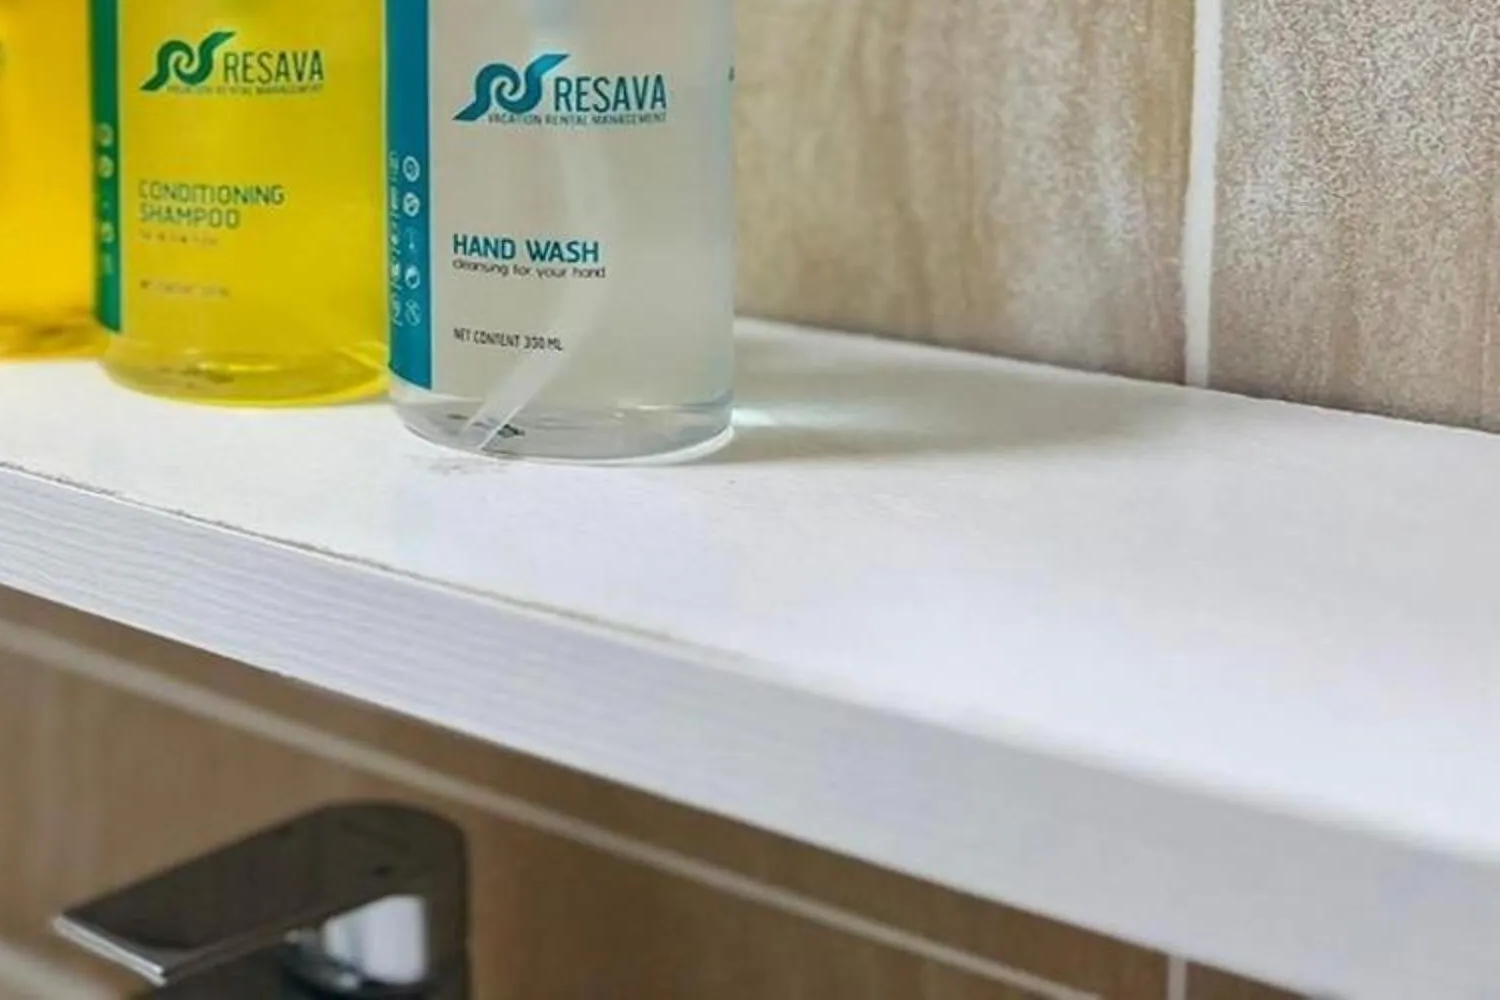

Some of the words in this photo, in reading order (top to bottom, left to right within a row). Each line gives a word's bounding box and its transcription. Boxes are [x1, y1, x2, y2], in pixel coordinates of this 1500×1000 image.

[224, 50, 324, 84] RESAVA
[554, 74, 667, 112] RESAVA
[488, 113, 542, 126] VACATION
[545, 114, 587, 126] RENTAL
[592, 112, 667, 125] MANAGEMENT
[138, 179, 286, 206] CONDITIONING
[139, 203, 241, 229] SHAMPOO
[453, 233, 517, 260] HAND
[525, 238, 599, 263] WASH
[452, 258, 509, 277] cleansing
[513, 263, 531, 276] for
[535, 267, 567, 279] your
[573, 266, 606, 279] hand
[453, 327, 471, 342] NET
[473, 330, 520, 348] CONTENT
[547, 336, 563, 351] ML
